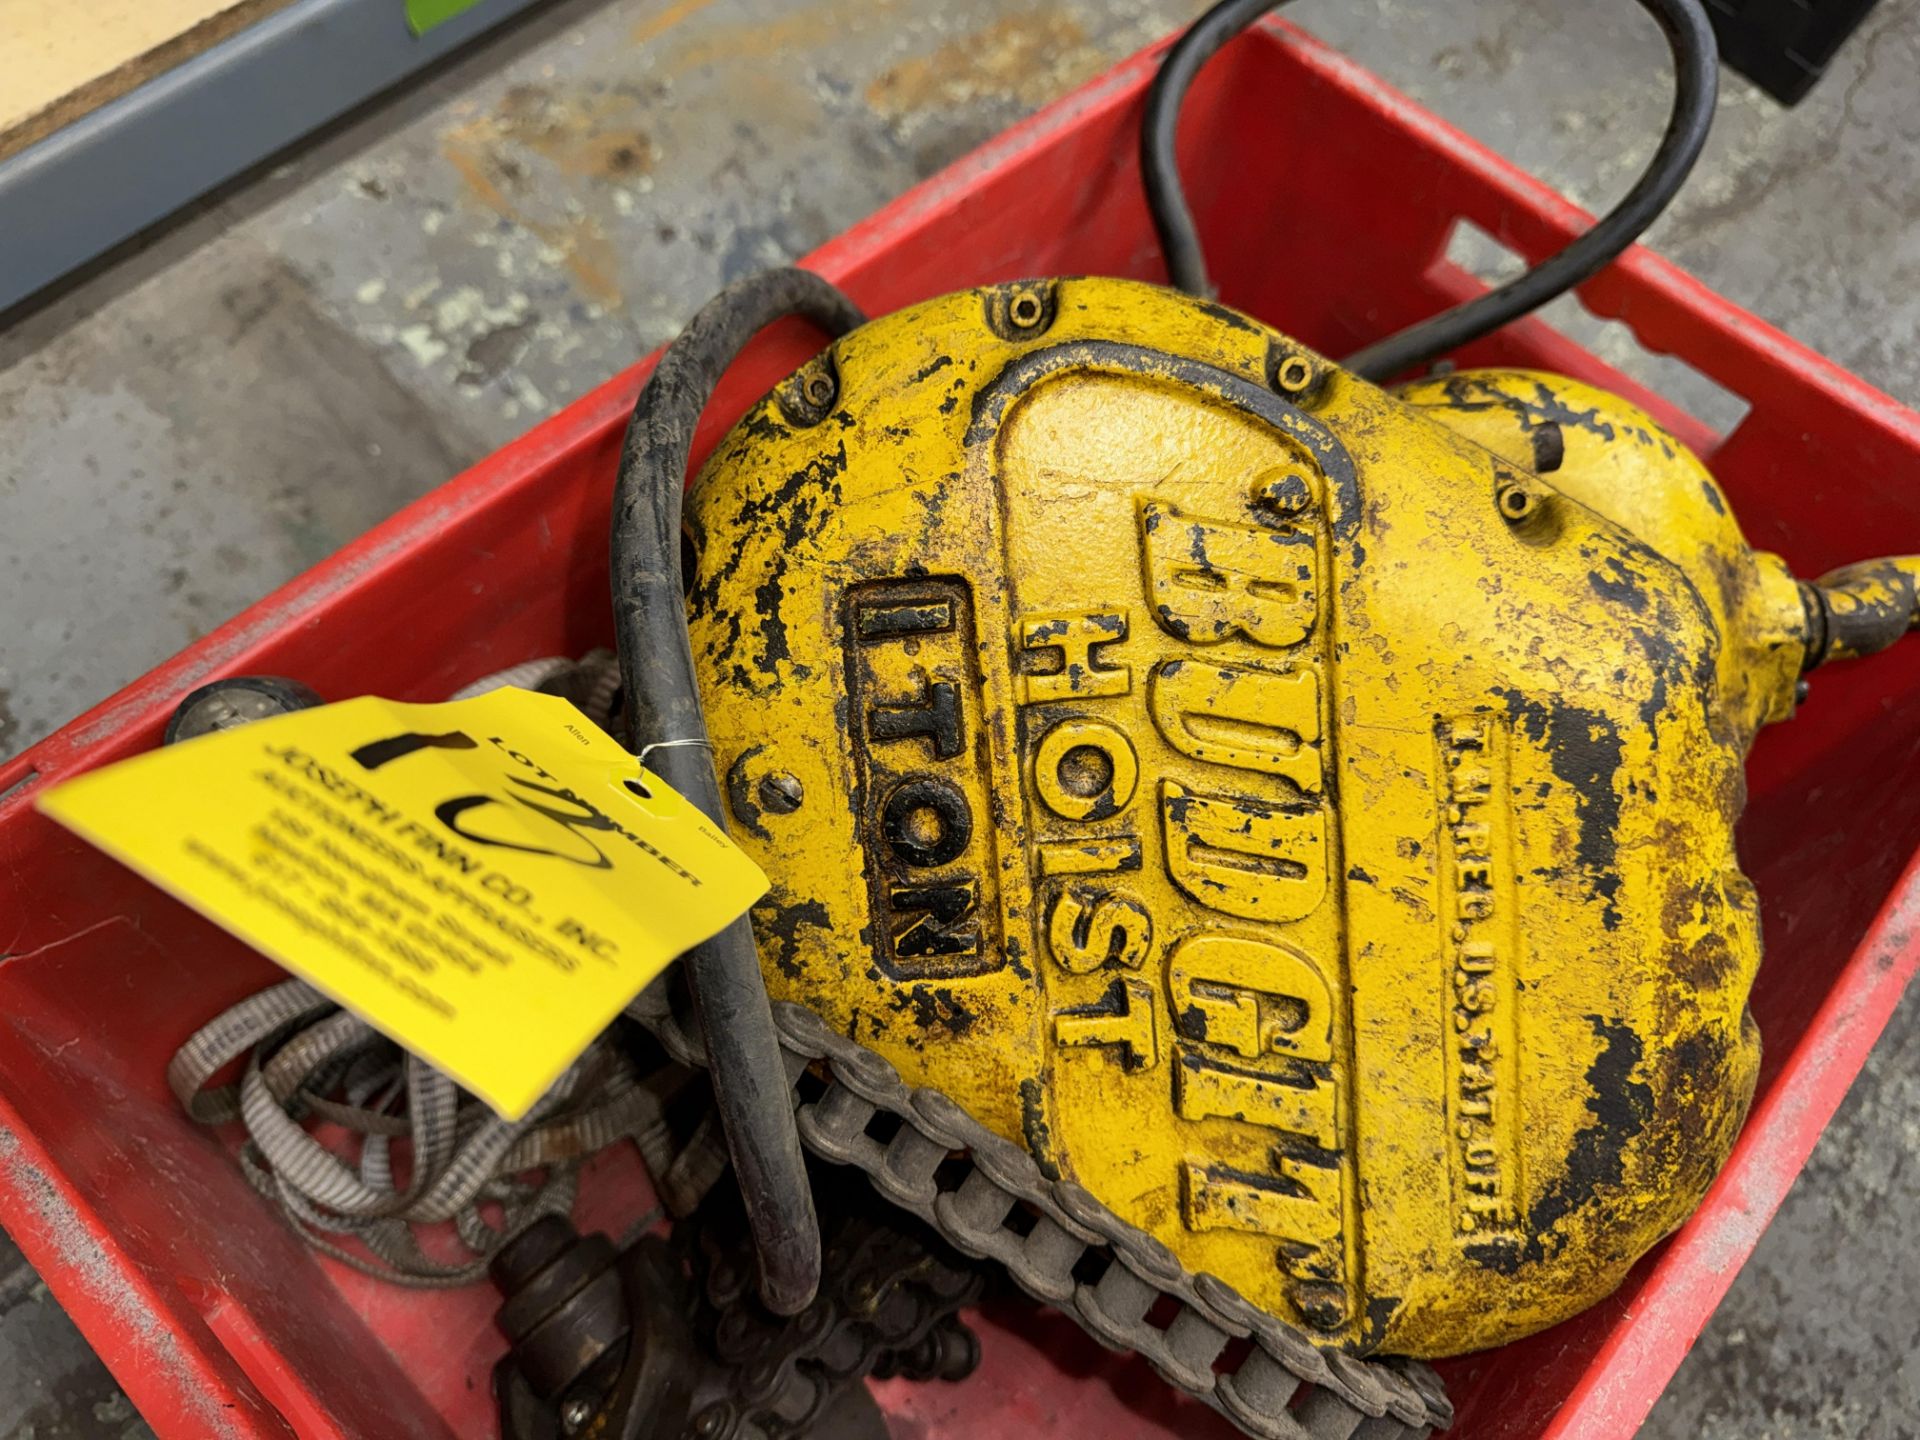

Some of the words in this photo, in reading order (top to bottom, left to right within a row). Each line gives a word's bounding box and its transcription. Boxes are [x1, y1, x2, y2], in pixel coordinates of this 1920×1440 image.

[262, 743, 402, 824] JOSEPH
[396, 821, 482, 873] FINN
[487, 737, 558, 782] LOT
[564, 724, 590, 746] Allen
[868, 681, 981, 957] TON
[1022, 609, 1156, 1073] HOIST
[1138, 498, 1343, 1283] BUDGIT
